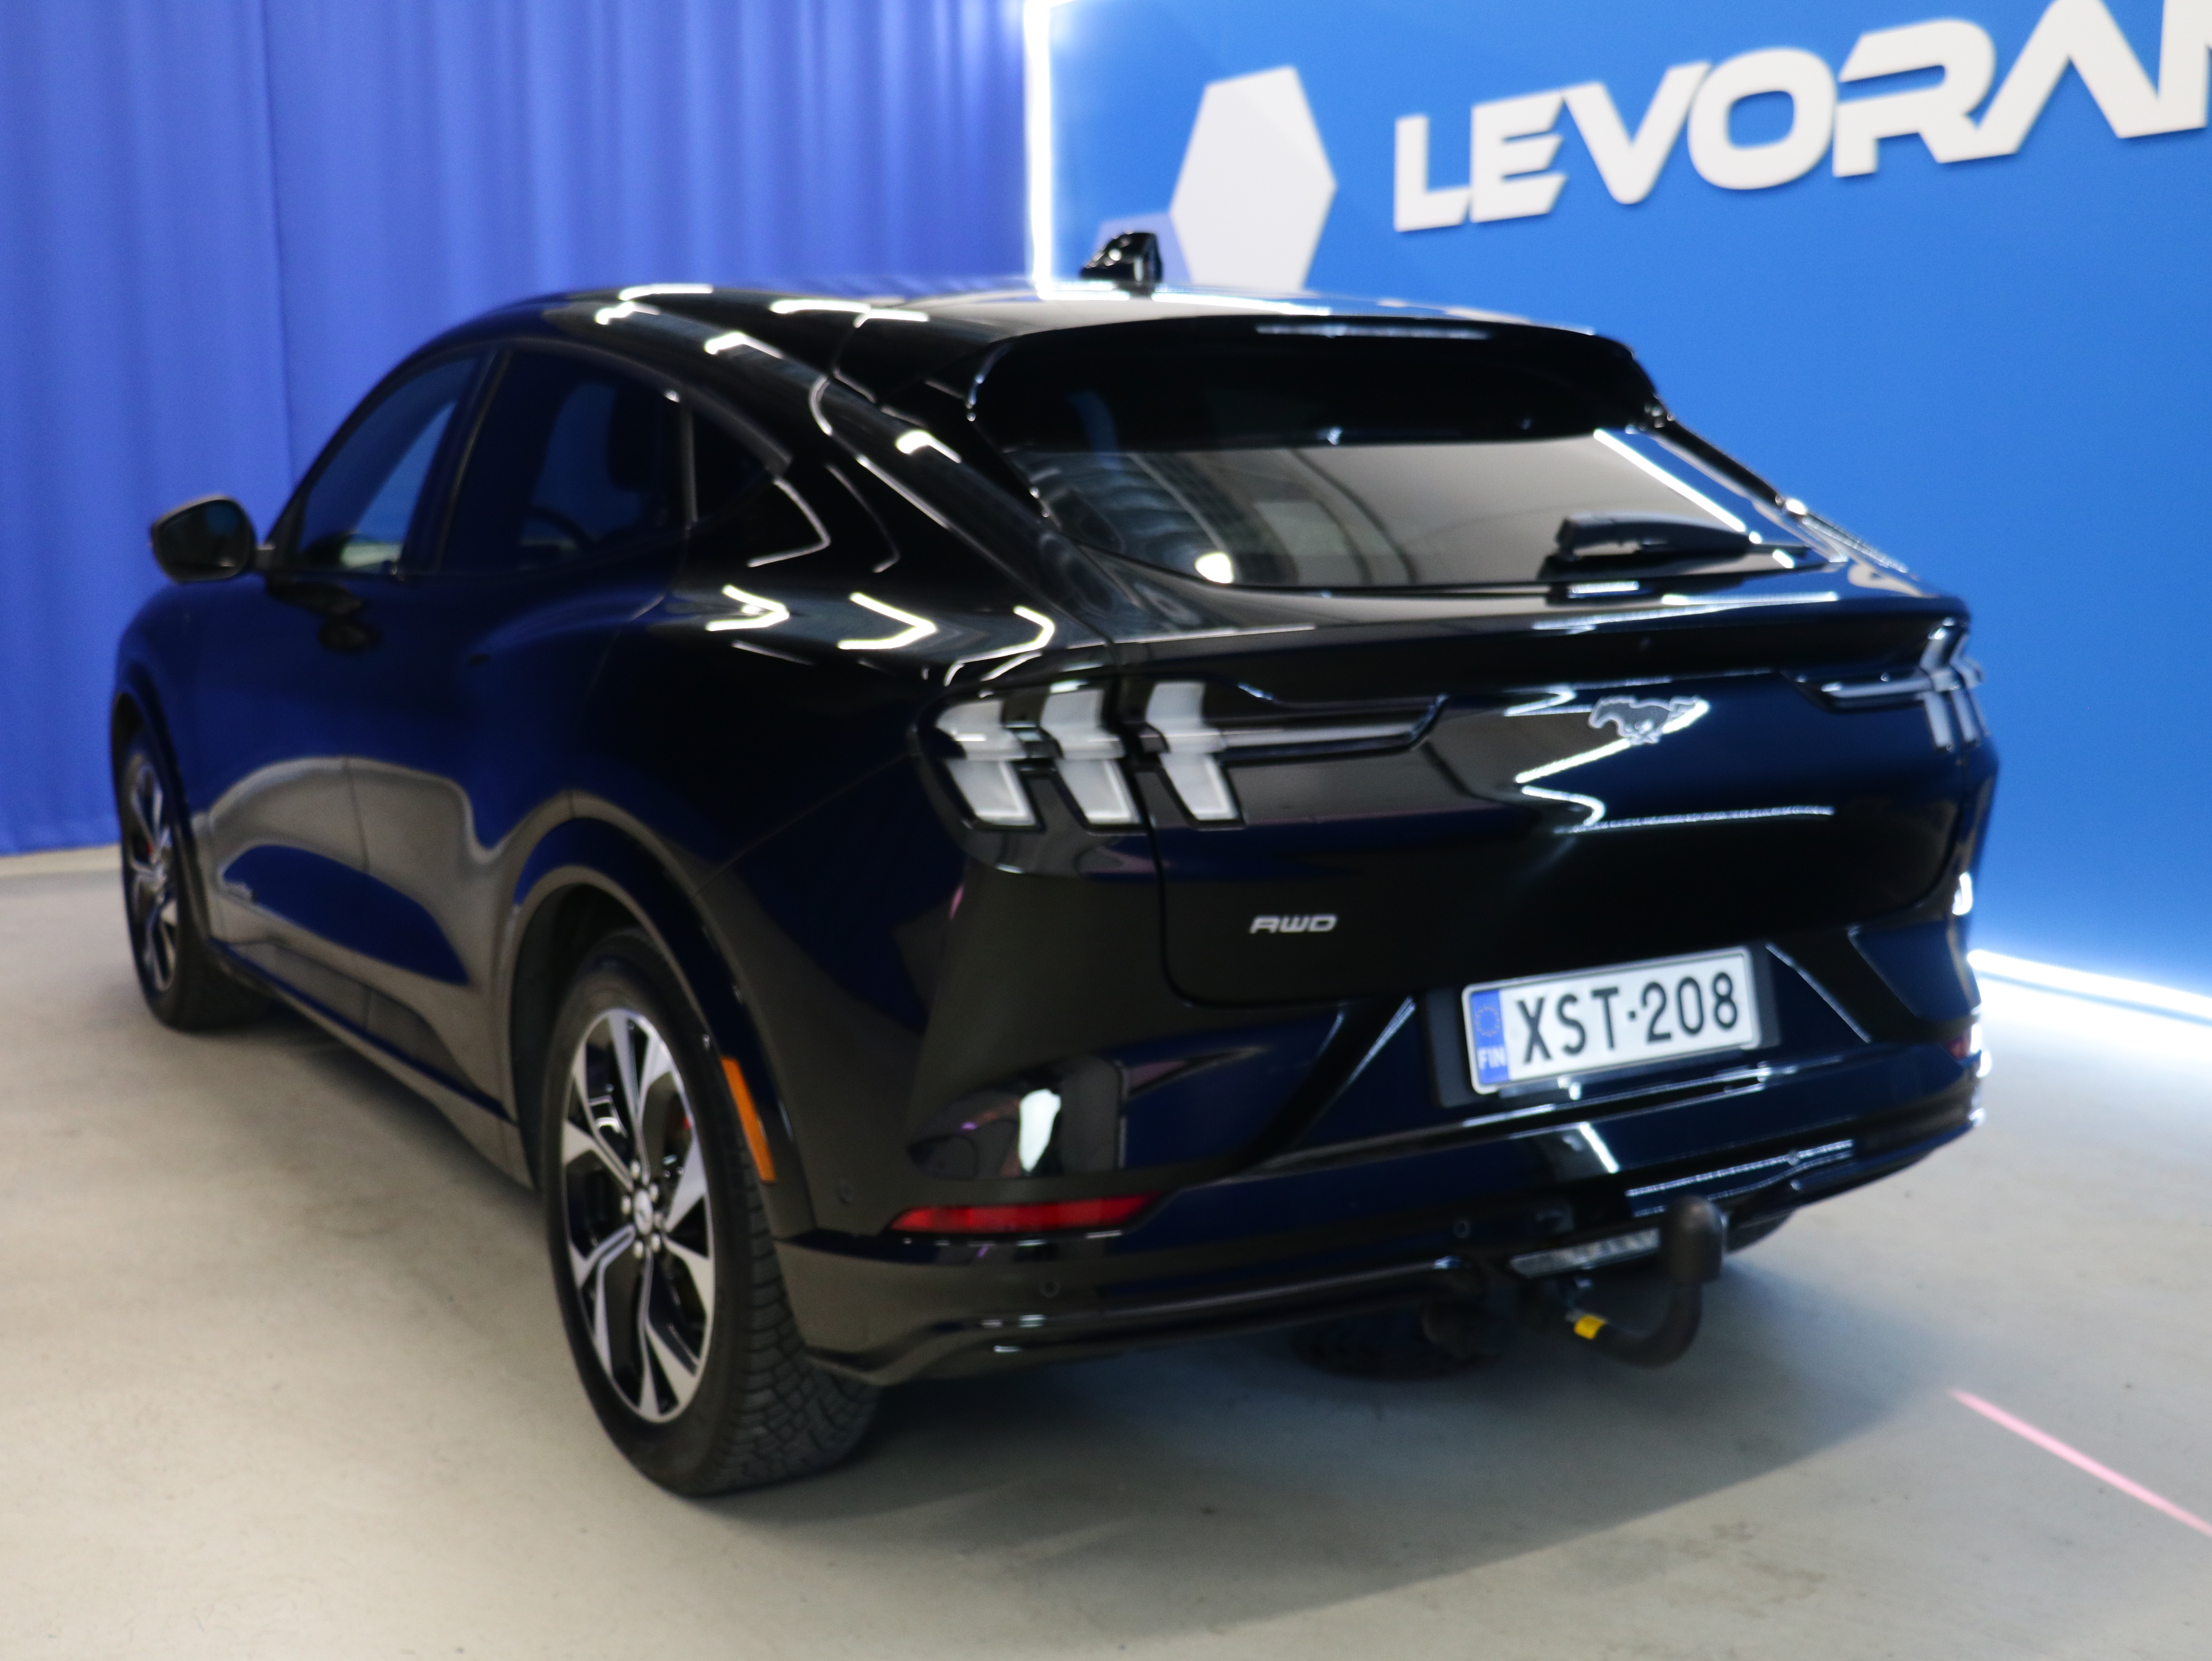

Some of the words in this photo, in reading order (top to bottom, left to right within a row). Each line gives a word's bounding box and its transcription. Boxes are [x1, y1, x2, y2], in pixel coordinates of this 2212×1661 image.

[1249, 915, 1338, 934] AWD
[1515, 971, 1738, 1066] XST-208
[1478, 1046, 1506, 1070] FIN
